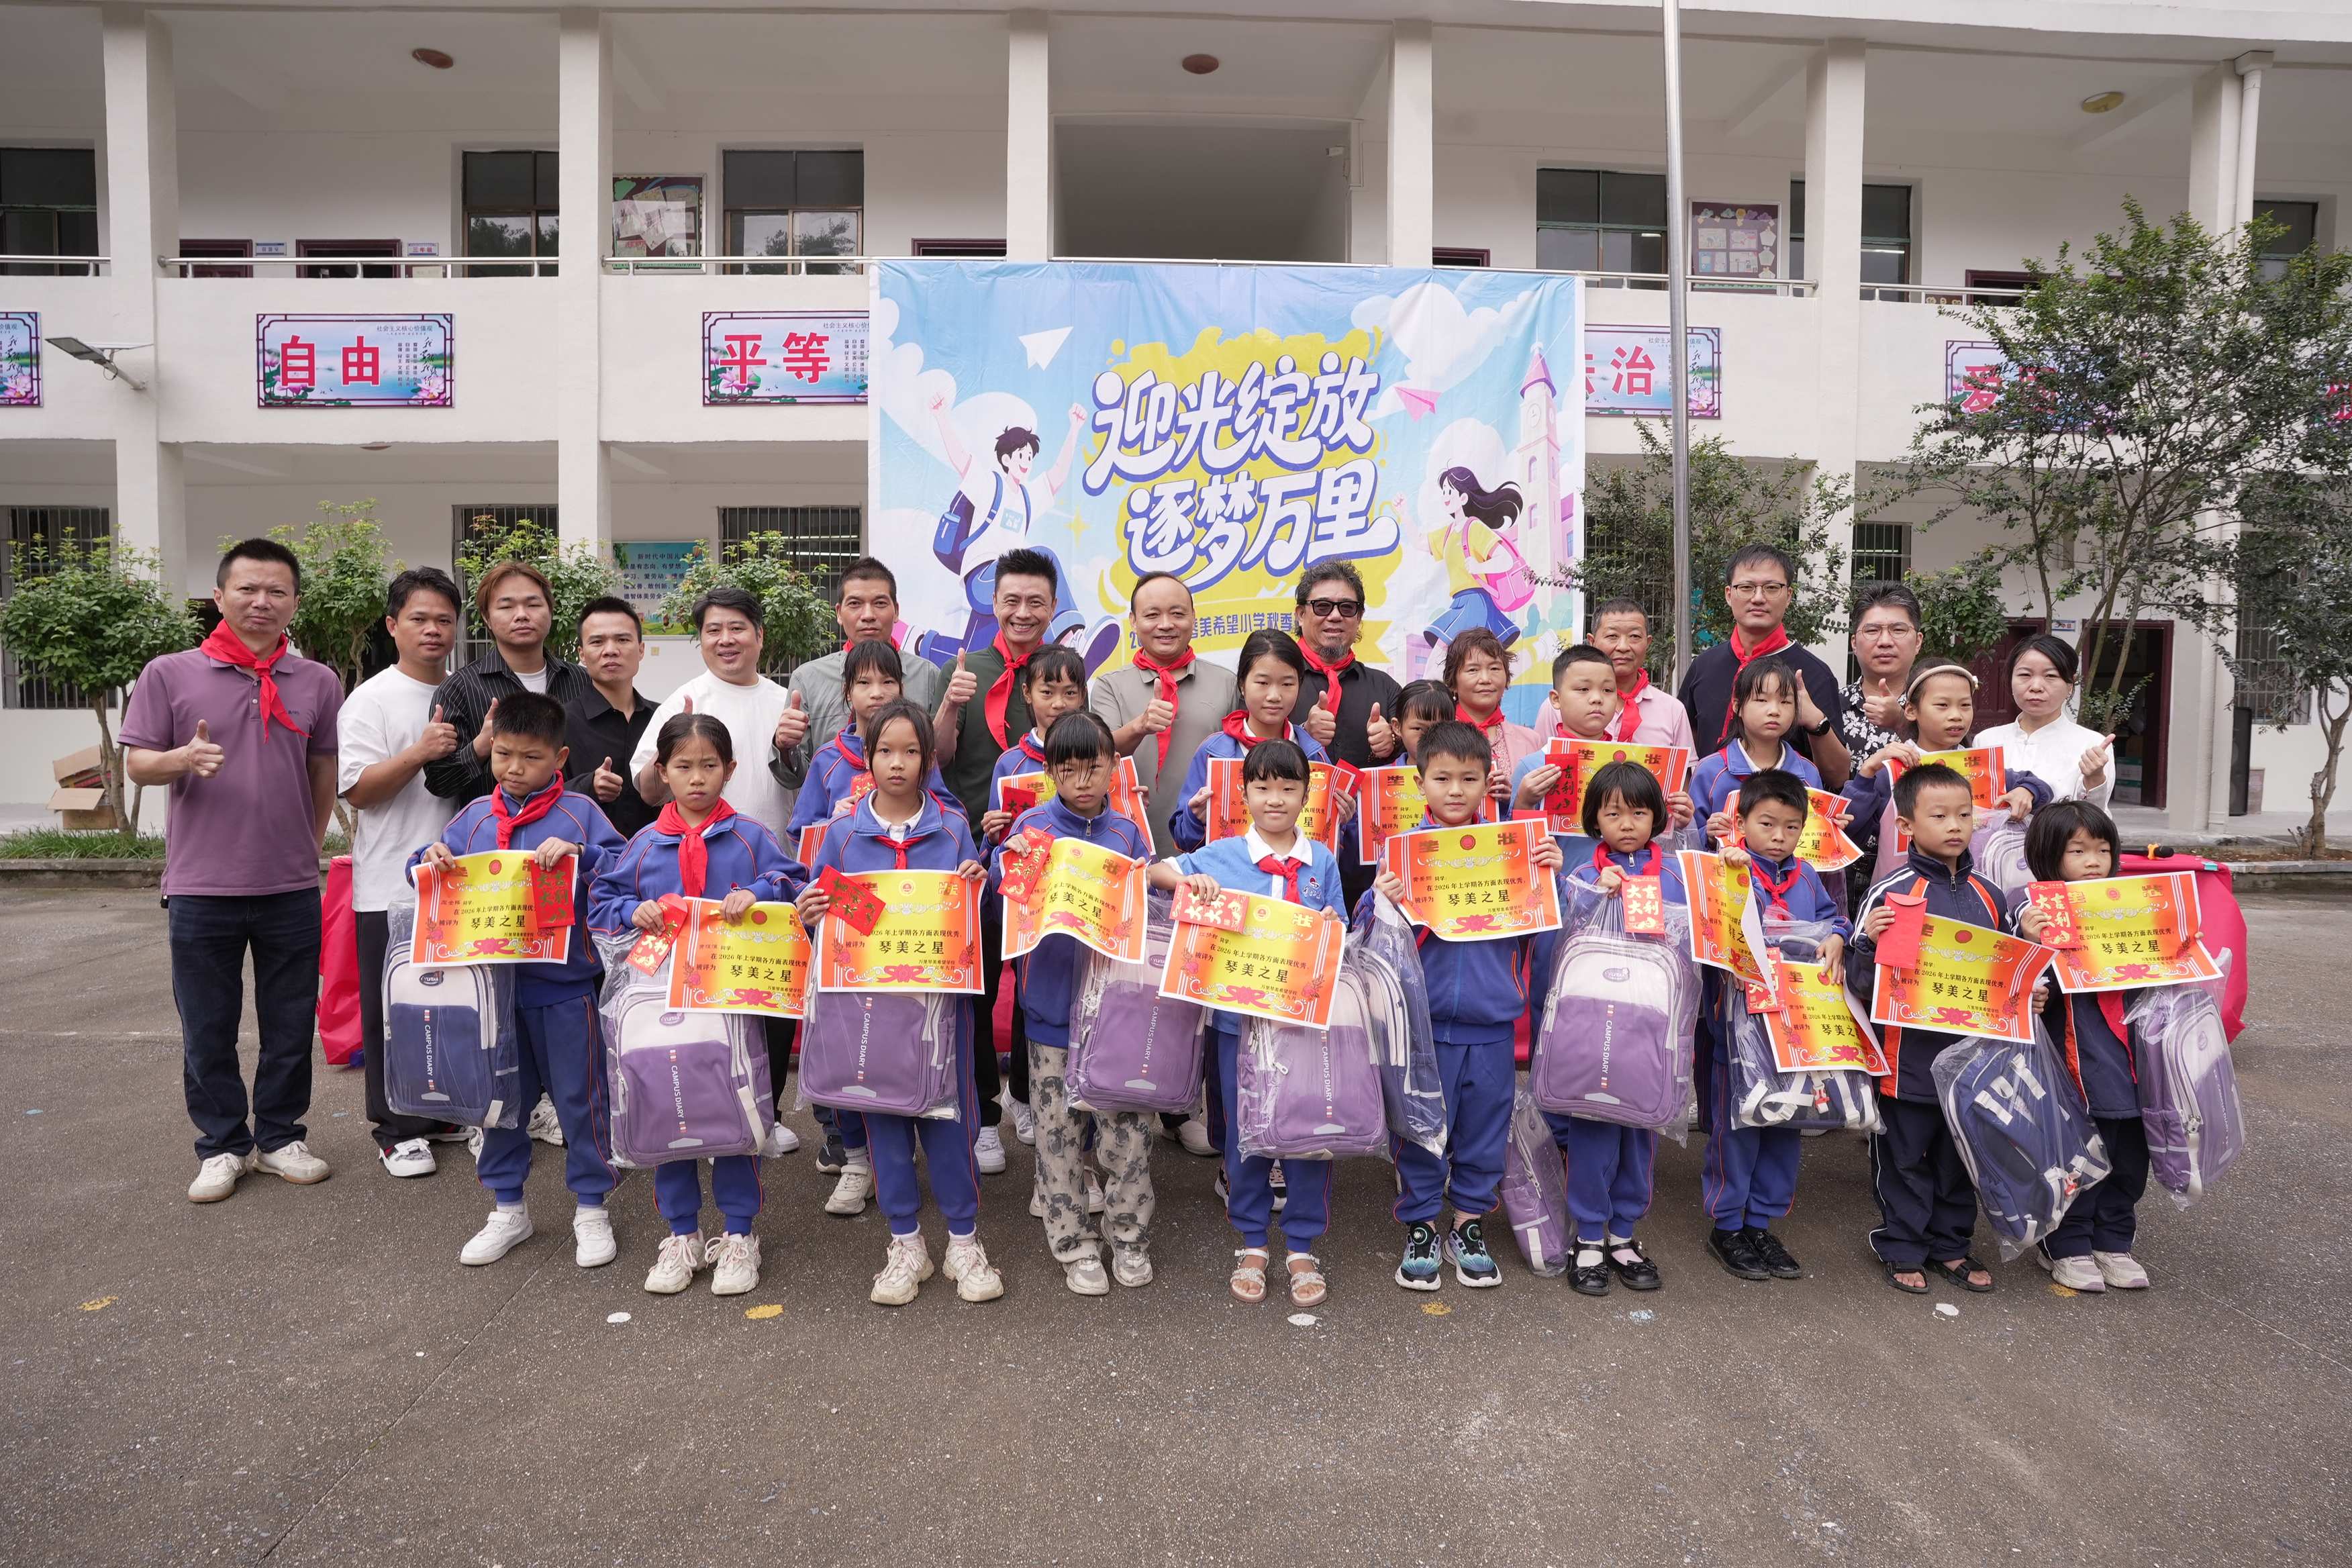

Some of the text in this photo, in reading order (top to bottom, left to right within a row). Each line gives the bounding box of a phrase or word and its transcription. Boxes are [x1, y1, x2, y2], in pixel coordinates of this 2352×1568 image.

[280, 335, 380, 387] 自由
[720, 332, 831, 384] 平等
[1083, 351, 1380, 495] 迎光绽放
[1125, 459, 1400, 592] 逐梦万里
[1050, 891, 1102, 920] 琴美之星
[1448, 890, 1510, 906] 琴美之星
[1627, 884, 1657, 899] 大吉
[2036, 893, 2065, 910] 大吉
[454, 905, 536, 916] 在2026年上学期各方面表现优
[471, 916, 526, 929] 琴美之星
[1628, 901, 1659, 915] 大利
[879, 940, 944, 954] 琴美之星
[2101, 940, 2160, 954] 琴美之星
[730, 965, 791, 983] 琴美之星
[1195, 951, 1289, 983] 被评为 琴美之星
[1900, 977, 1989, 1003] 被评为 琴美之星
[424, 1025, 432, 1055] CAMPUS
[859, 1013, 871, 1067] CAMPUS DIARY
[1144, 1006, 1159, 1061] CAMPUS DIARY
[1602, 1020, 1612, 1074] CAMPUS DIARY
[1322, 1046, 1332, 1102] CAMPUS DIARY
[671, 1065, 685, 1118] CAMPUS DIARY
